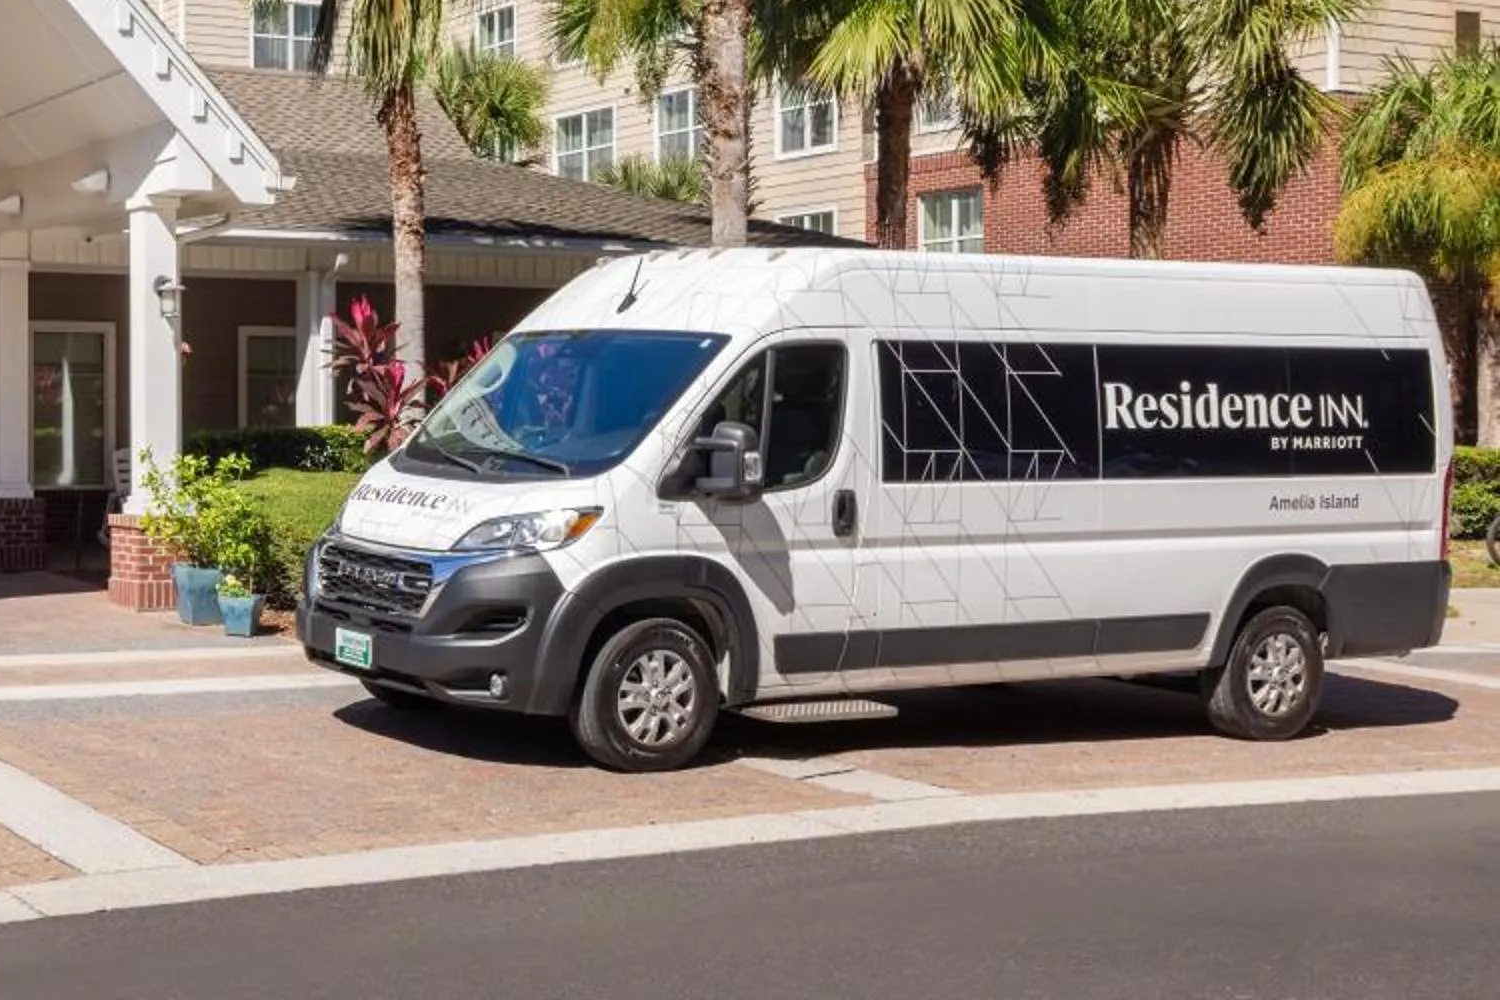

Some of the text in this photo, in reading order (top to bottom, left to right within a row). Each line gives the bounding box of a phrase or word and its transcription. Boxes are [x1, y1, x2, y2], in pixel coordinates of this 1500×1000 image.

[1103, 380, 1312, 429] Residence
[1271, 435, 1363, 449] BY MARRIOTT
[351, 484, 447, 509] Residence
[1269, 493, 1360, 511] Amelia Island
